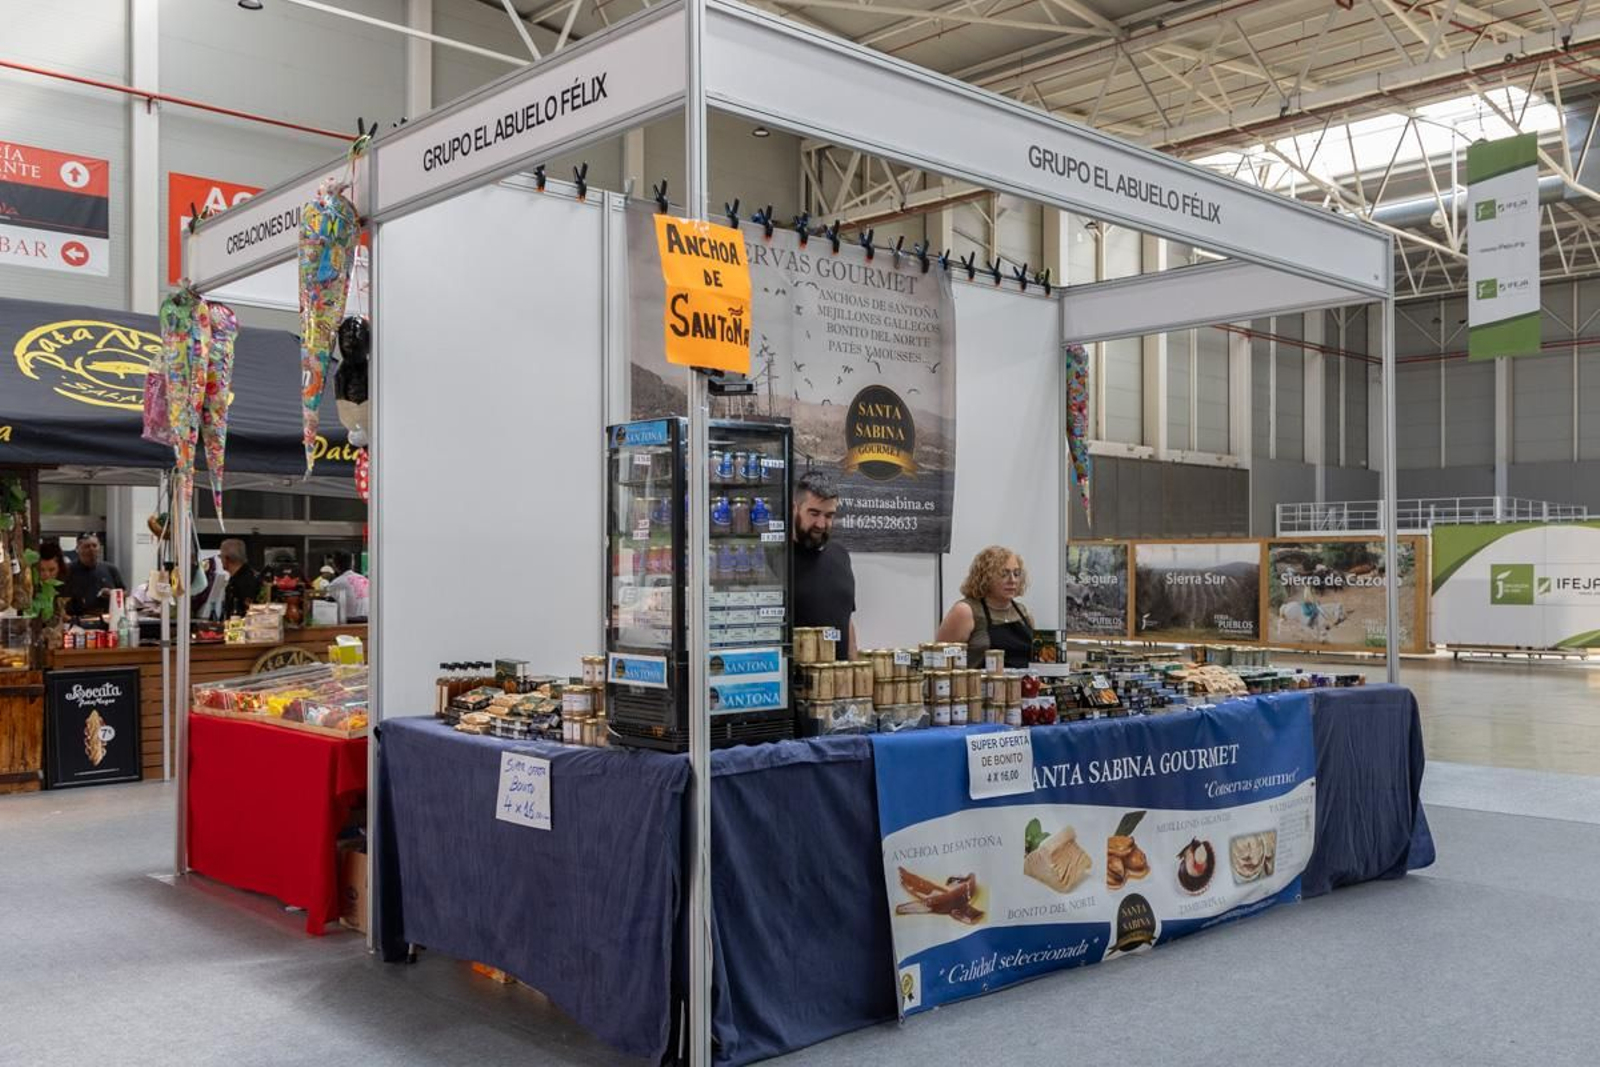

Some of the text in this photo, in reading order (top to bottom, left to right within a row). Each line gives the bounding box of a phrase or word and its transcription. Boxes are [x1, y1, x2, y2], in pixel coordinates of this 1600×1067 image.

[423, 72, 608, 172] GRUPO EL ABUELO FÉLIX
[0, 160, 42, 179] NTE
[1028, 145, 1222, 225] GRUPO EL ABUELO FÉLIX
[227, 216, 283, 255] CREACIONES
[666, 223, 741, 266] ANCHOA
[0, 235, 49, 259] BAR
[703, 269, 723, 288] DE
[816, 257, 918, 295] GOURMET
[819, 288, 939, 320] ANCHOAS DE SANTOÑA
[669, 293, 750, 348] SANTOÑA
[817, 304, 941, 334] MEJILLONES GALLEGOS
[826, 322, 932, 348] BONITO DEL NORTE
[828, 339, 863, 355] PATÉS
[857, 401, 902, 420] SANTA
[855, 422, 905, 441] SABINA
[857, 444, 901, 457] GOURMET
[856, 517, 918, 531] 625528633
[1078, 573, 1118, 587] Segura
[1166, 572, 1226, 585] Sierra Sur
[1280, 573, 1321, 586] Sierra
[1324, 572, 1342, 586] de
[1218, 620, 1254, 629] PUEBLOS
[65, 682, 123, 701] Bocata
[971, 735, 1030, 751] SUPER OFERTA
[981, 752, 1023, 767] DE BONITO
[1032, 743, 1240, 789] ANTA SABINA GOURMET
[891, 844, 939, 862] ANCHOA
[956, 835, 1004, 852] SANTOÑA
[1007, 896, 1096, 920] BONITO DEL NORTE
[1121, 904, 1147, 918] SANTA
[1121, 917, 1151, 931] SABINA
[948, 938, 1089, 984] Calidad seleccionada
